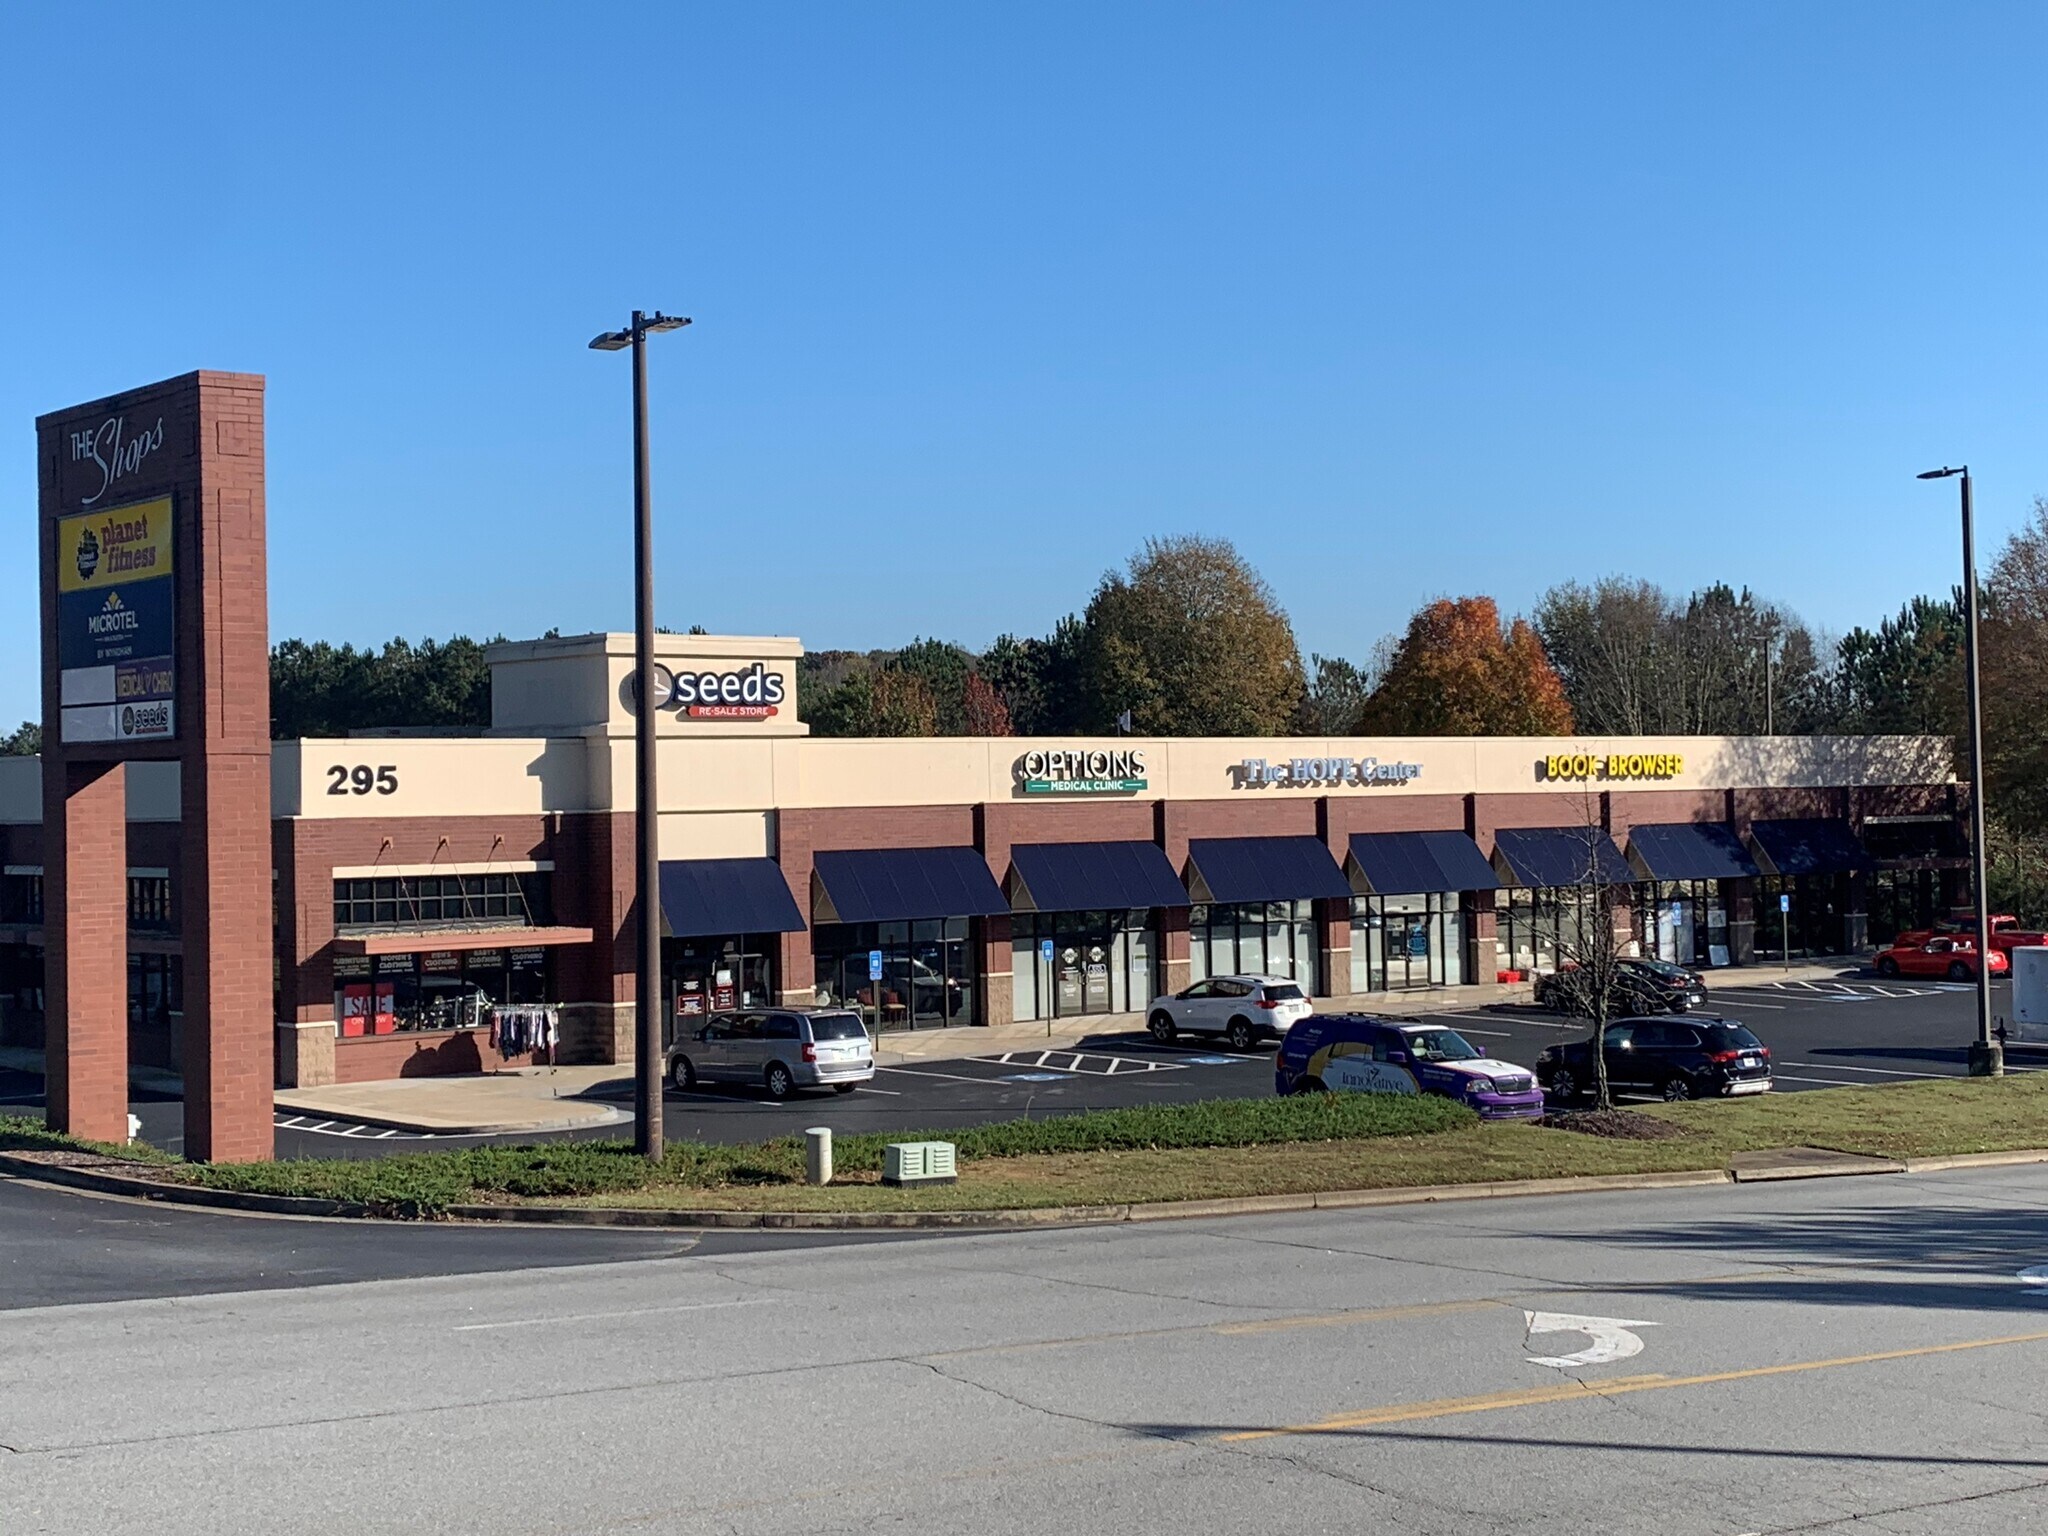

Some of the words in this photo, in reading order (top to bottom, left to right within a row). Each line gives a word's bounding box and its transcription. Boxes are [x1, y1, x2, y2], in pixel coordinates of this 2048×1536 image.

[70, 429, 94, 461] THE
[81, 417, 164, 504] Shops
[101, 512, 148, 554] planet
[107, 546, 156, 574] fitness
[88, 610, 139, 634] MICROTEL
[676, 664, 784, 703] seeds
[135, 702, 169, 728] seeds
[739, 706, 769, 716] STORE
[1023, 750, 1147, 779] OPTIONS
[1242, 757, 1285, 782] The
[1290, 757, 1354, 781] HOPE
[1361, 757, 1424, 780] Center
[1546, 754, 1598, 777] BOOK
[1606, 754, 1684, 777] BROWSER
[326, 764, 399, 796] 295
[1050, 780, 1092, 791] MEDICAL
[1093, 780, 1124, 791] CLINIC
[351, 996, 386, 1016] SAE
